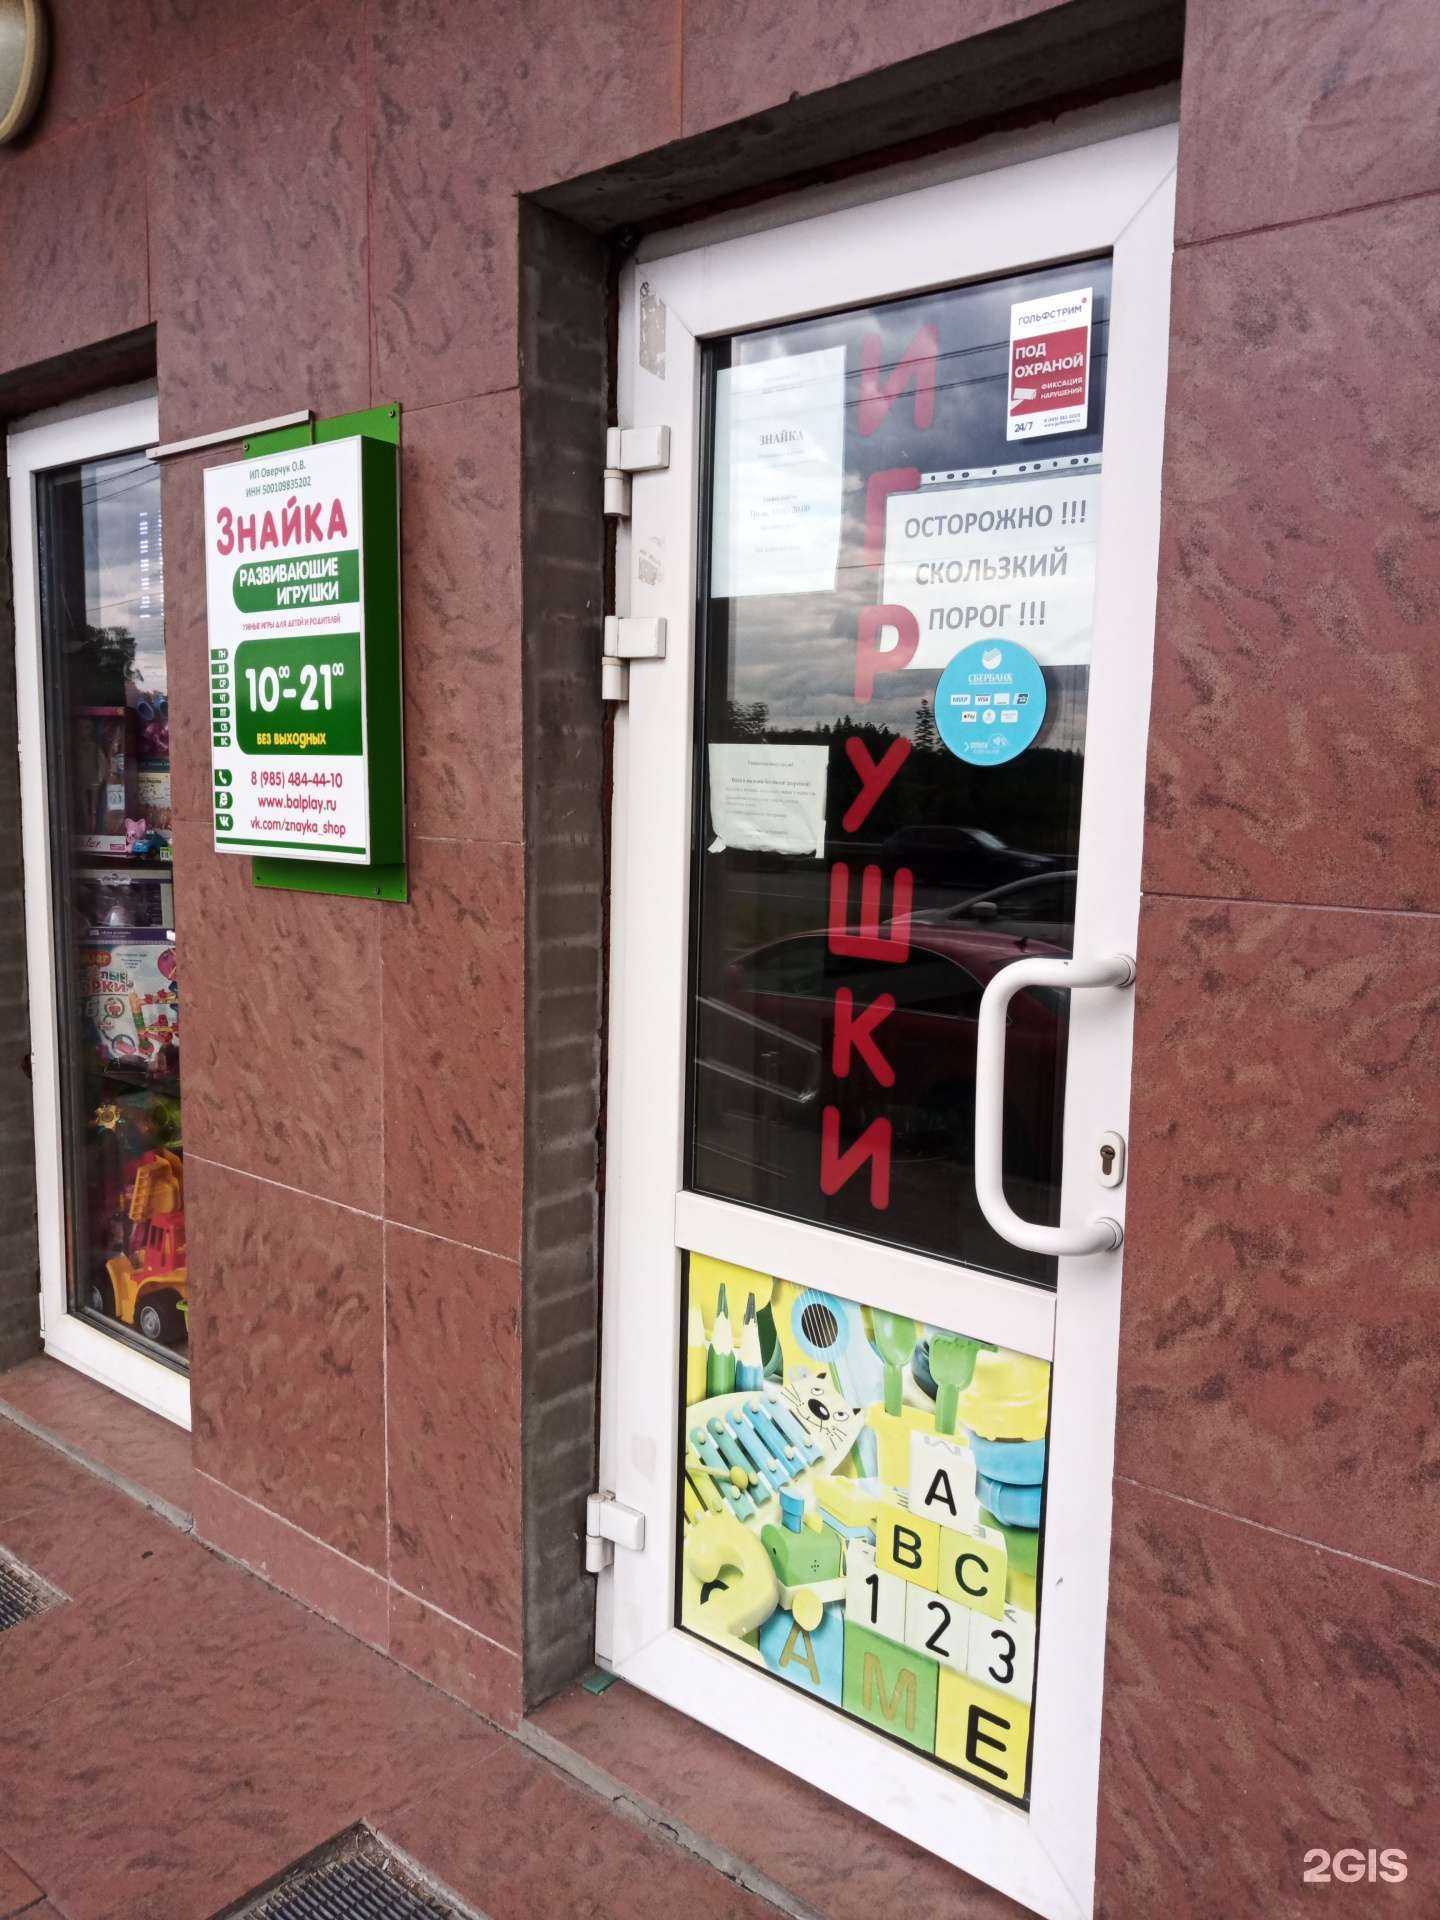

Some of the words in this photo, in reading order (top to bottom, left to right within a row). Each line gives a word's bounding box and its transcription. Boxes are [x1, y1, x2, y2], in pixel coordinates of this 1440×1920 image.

[1018, 305, 1082, 325] ГОЛЬФСТРИМ
[1015, 343, 1046, 360] ПОД
[1015, 353, 1084, 378] ОХРАНОЙ
[1041, 376, 1083, 390] ФИКСАЦИЯ
[1014, 421, 1033, 433] 24/7
[760, 429, 804, 446] ЗНАЙКА
[249, 469, 259, 480] ИП
[246, 485, 260, 497] ИНН
[216, 495, 348, 556] ЗНАЙКА
[904, 504, 1053, 538] ОСТОРОЖНО
[1061, 499, 1087, 525] !!!
[239, 557, 339, 587] РАЗВИВАЮЩИЕ
[915, 546, 1068, 586] СКОЛЬЗКИЙ
[276, 581, 339, 606] ИГРУШКИ
[276, 620, 287, 628] ДЛЯ
[928, 604, 1011, 631] ПОРОГ
[1019, 600, 1046, 627] !!!
[218, 650, 226, 659] ПН
[219, 679, 227, 688] СР
[219, 694, 227, 703] ЧТ
[220, 723, 228, 732] СБ
[256, 732, 271, 745] БЕЗ
[251, 771, 257, 786] 8
[260, 771, 285, 789] (985)
[288, 771, 343, 788] 484-44-10
[258, 794, 337, 815] www.balplay.ru
[250, 817, 346, 838] vk.com/znayka_shop
[924, 1467, 959, 1517] A
